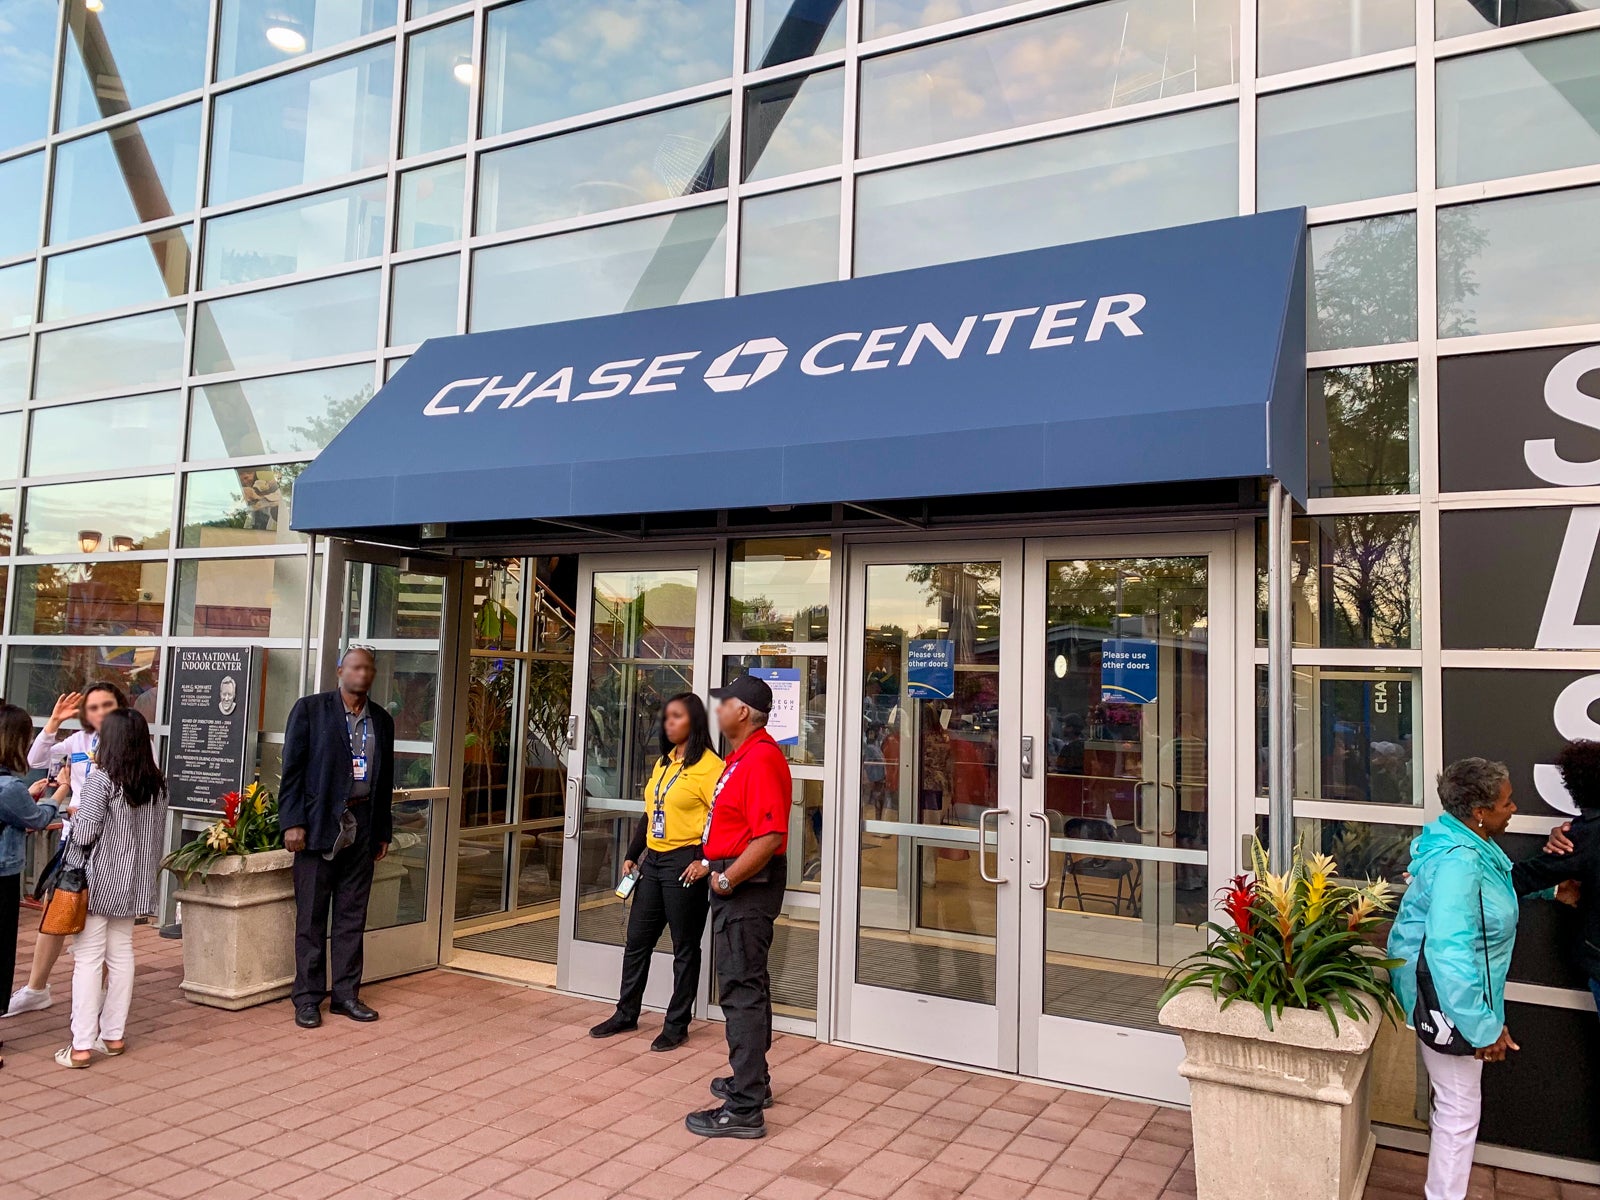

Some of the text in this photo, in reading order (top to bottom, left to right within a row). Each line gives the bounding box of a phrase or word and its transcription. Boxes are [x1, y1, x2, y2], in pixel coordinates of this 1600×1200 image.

[423, 294, 1146, 416] CHASE CENTER
[182, 651, 241, 661] USTA NATIONAL
[1102, 651, 1130, 659] Please
[181, 661, 242, 671] INDOOR CENTER
[1102, 661, 1125, 669] other
[1421, 1022, 1434, 1034] the
